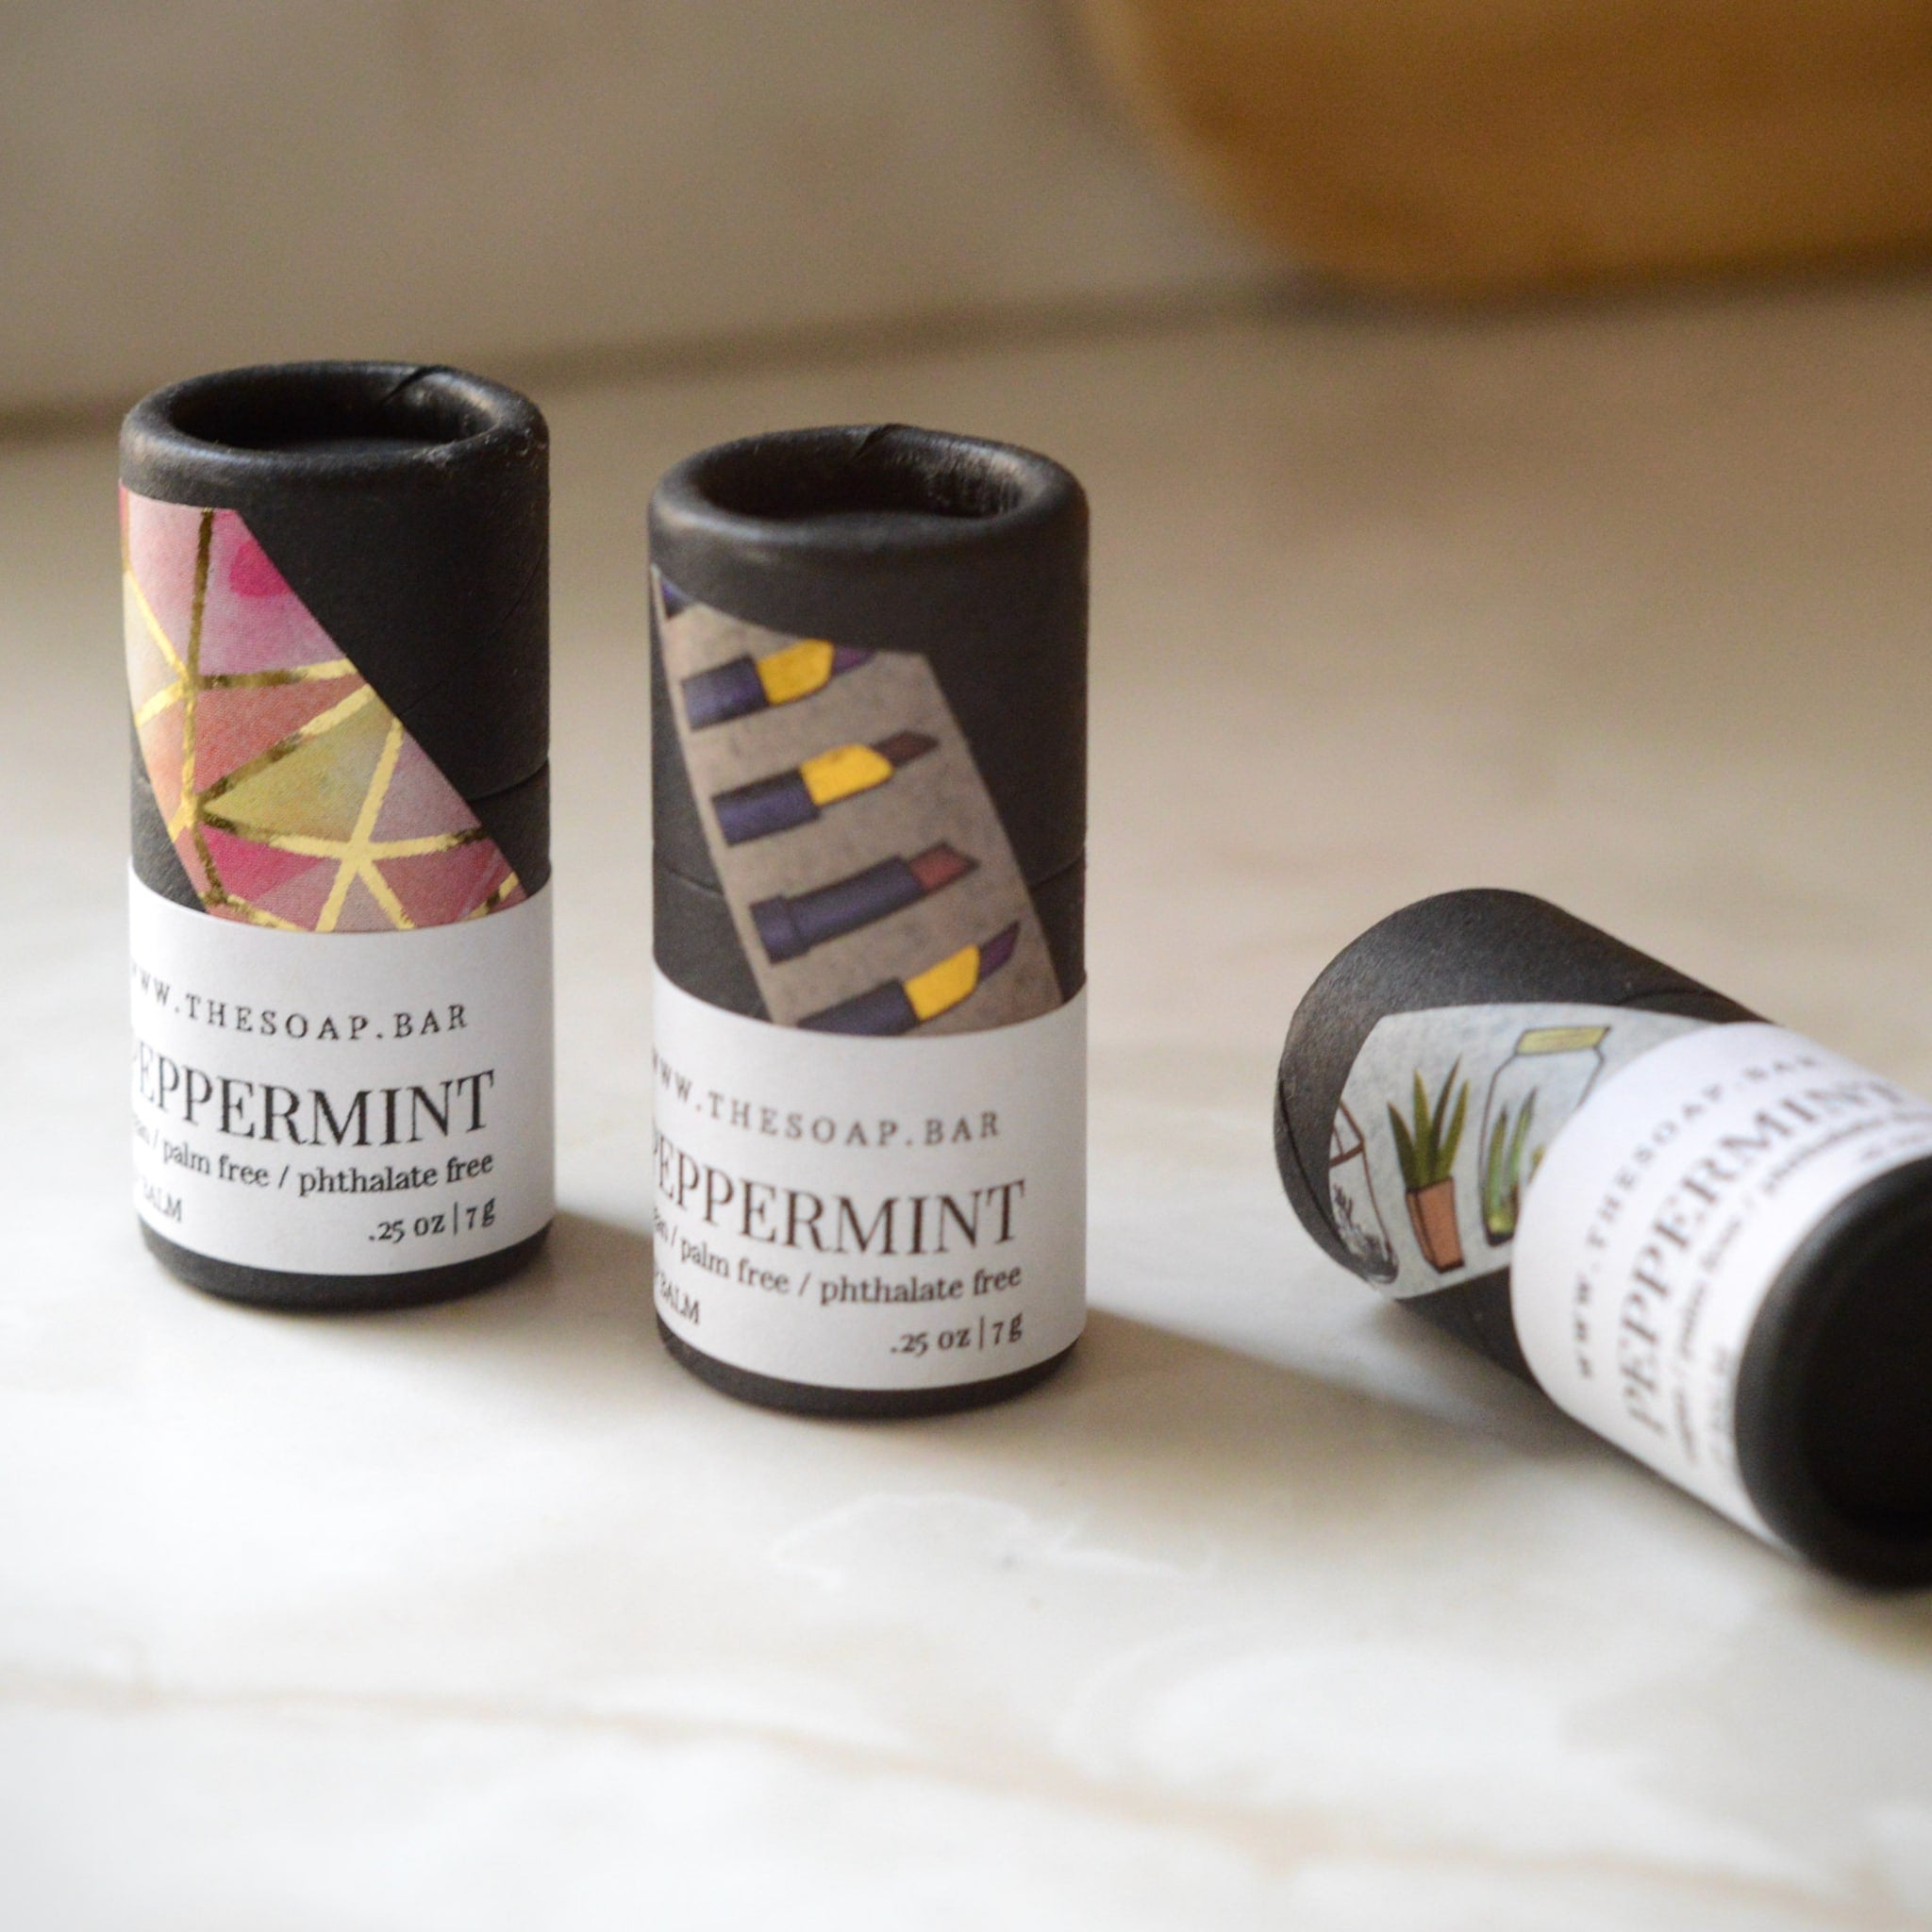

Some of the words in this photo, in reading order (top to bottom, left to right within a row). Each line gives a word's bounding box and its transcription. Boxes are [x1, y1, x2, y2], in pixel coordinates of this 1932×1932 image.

[134, 1041, 495, 1147] EPPERMINT
[163, 1139, 210, 1175] palm
[218, 1154, 270, 1188] free
[299, 1165, 438, 1198] phthalate
[447, 1153, 493, 1183] free
[368, 1219, 406, 1244] .25
[413, 1212, 446, 1237] oz
[680, 1237, 729, 1277] palm
[738, 1257, 791, 1295] free
[820, 1275, 964, 1306] phthalate
[974, 1266, 1022, 1296] free
[891, 1332, 929, 1358] .25
[938, 1328, 971, 1351] oz
